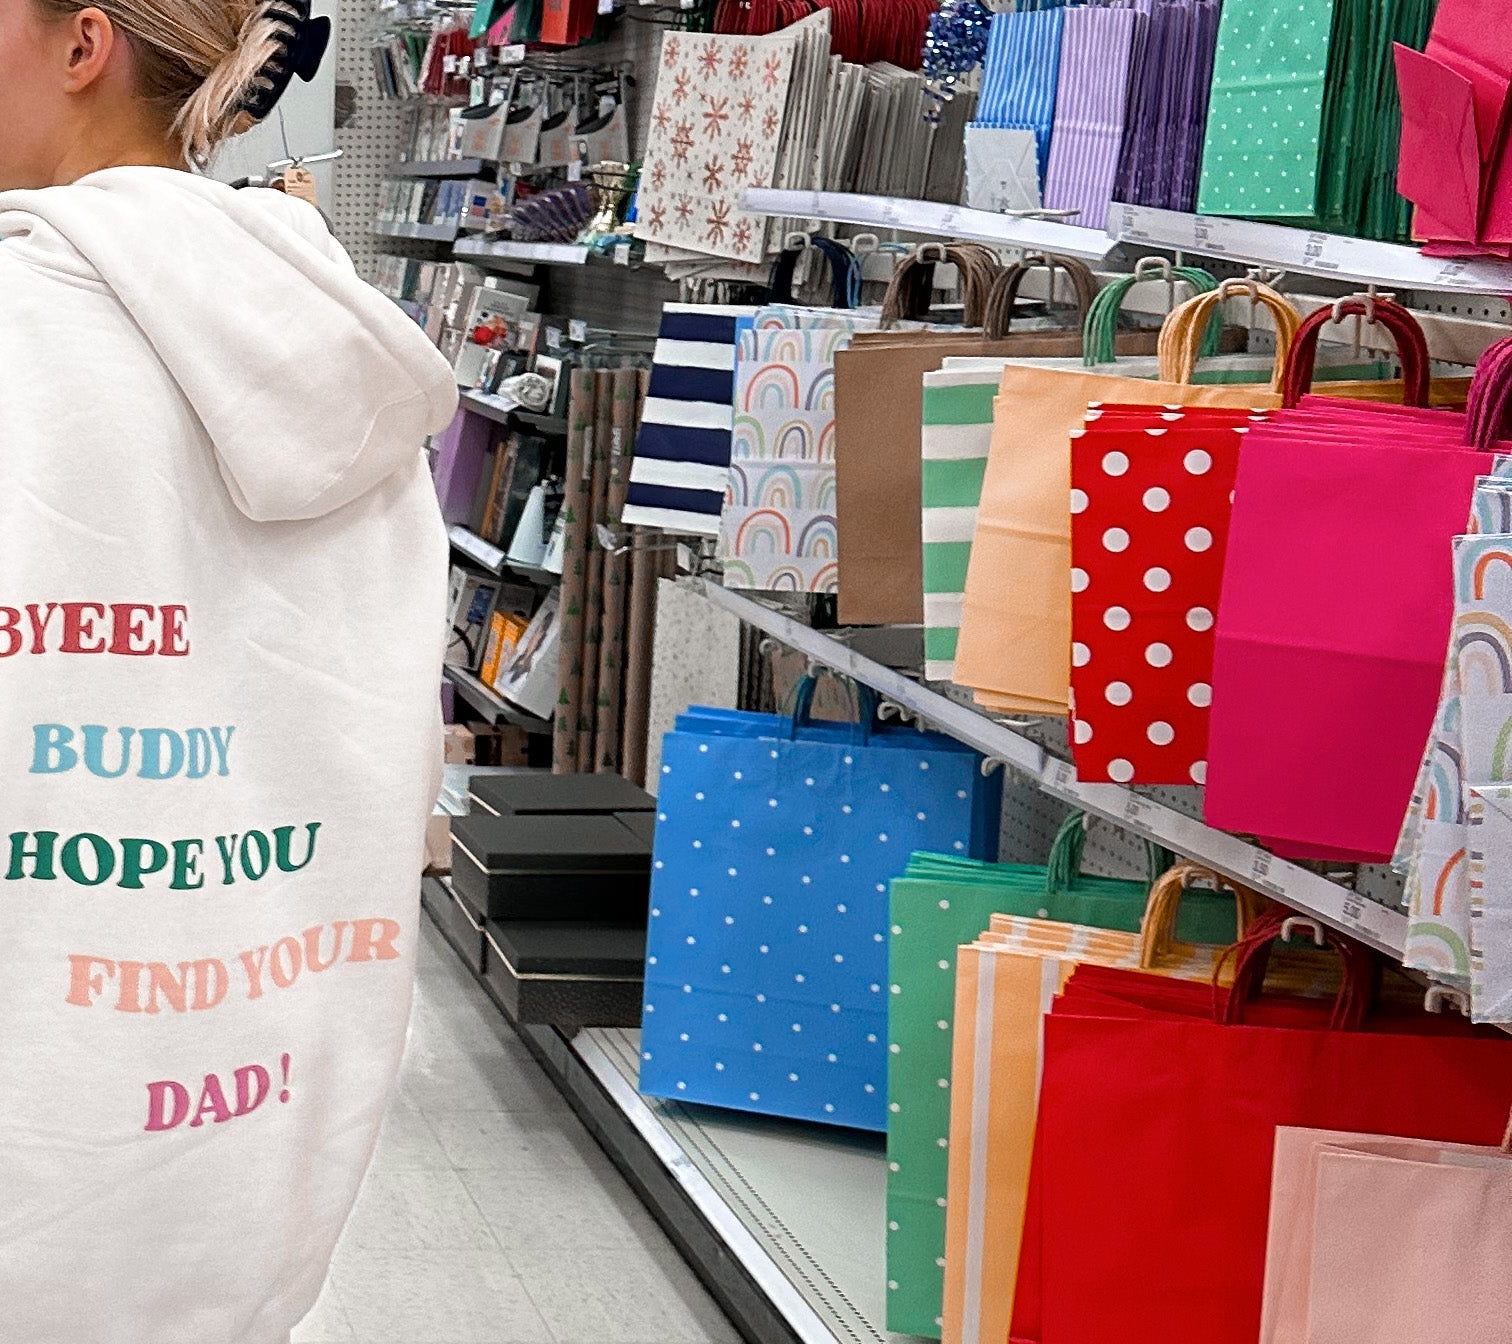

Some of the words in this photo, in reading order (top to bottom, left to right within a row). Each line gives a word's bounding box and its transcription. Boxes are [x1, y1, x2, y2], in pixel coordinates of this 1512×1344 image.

[28, 723, 236, 780] BUDDY
[4, 830, 205, 890] HOPE
[215, 822, 322, 885] YOU
[64, 954, 229, 1015] FIND
[236, 916, 402, 1001] YOUR
[144, 1052, 291, 1132] DAD!
